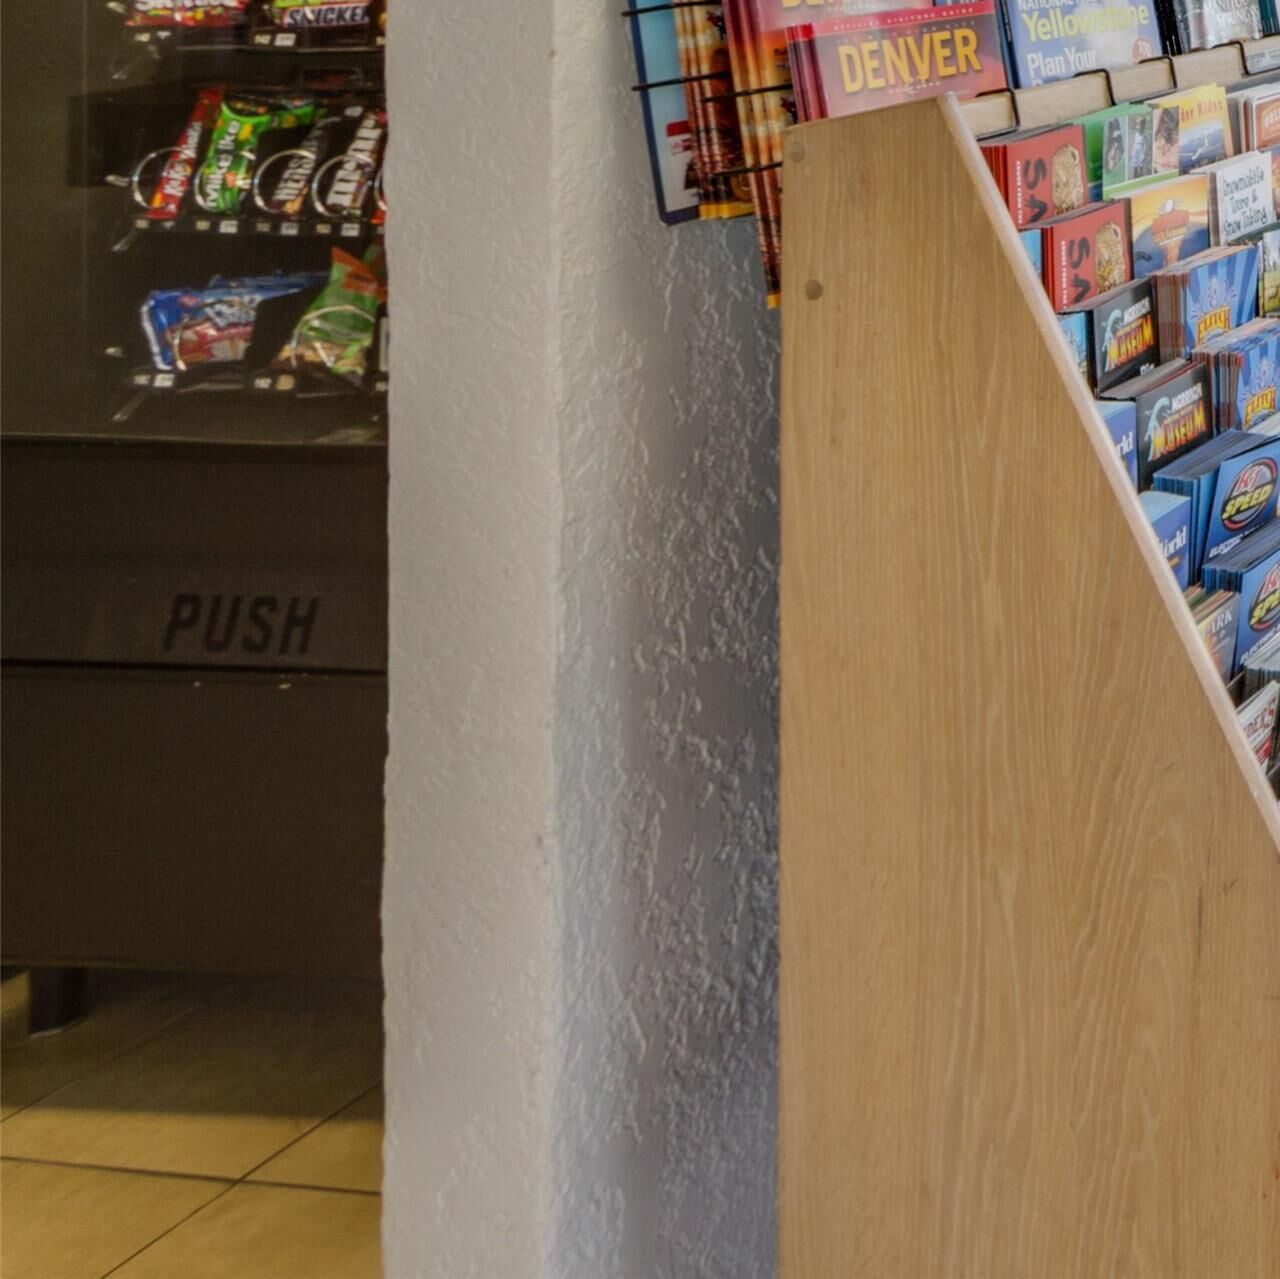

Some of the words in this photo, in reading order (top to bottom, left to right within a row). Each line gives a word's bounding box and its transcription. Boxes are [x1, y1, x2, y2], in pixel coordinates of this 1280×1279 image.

[1021, 4, 1149, 42] Yellowstone
[838, 27, 982, 94] DENVER
[1027, 51, 1065, 80] Plan
[1064, 46, 1097, 70] Your
[216, 120, 240, 150] Ike
[203, 154, 235, 209] Mike
[1151, 400, 1206, 462] MUSEUM
[1222, 483, 1274, 521] SPEED
[162, 592, 320, 655] PUSH
